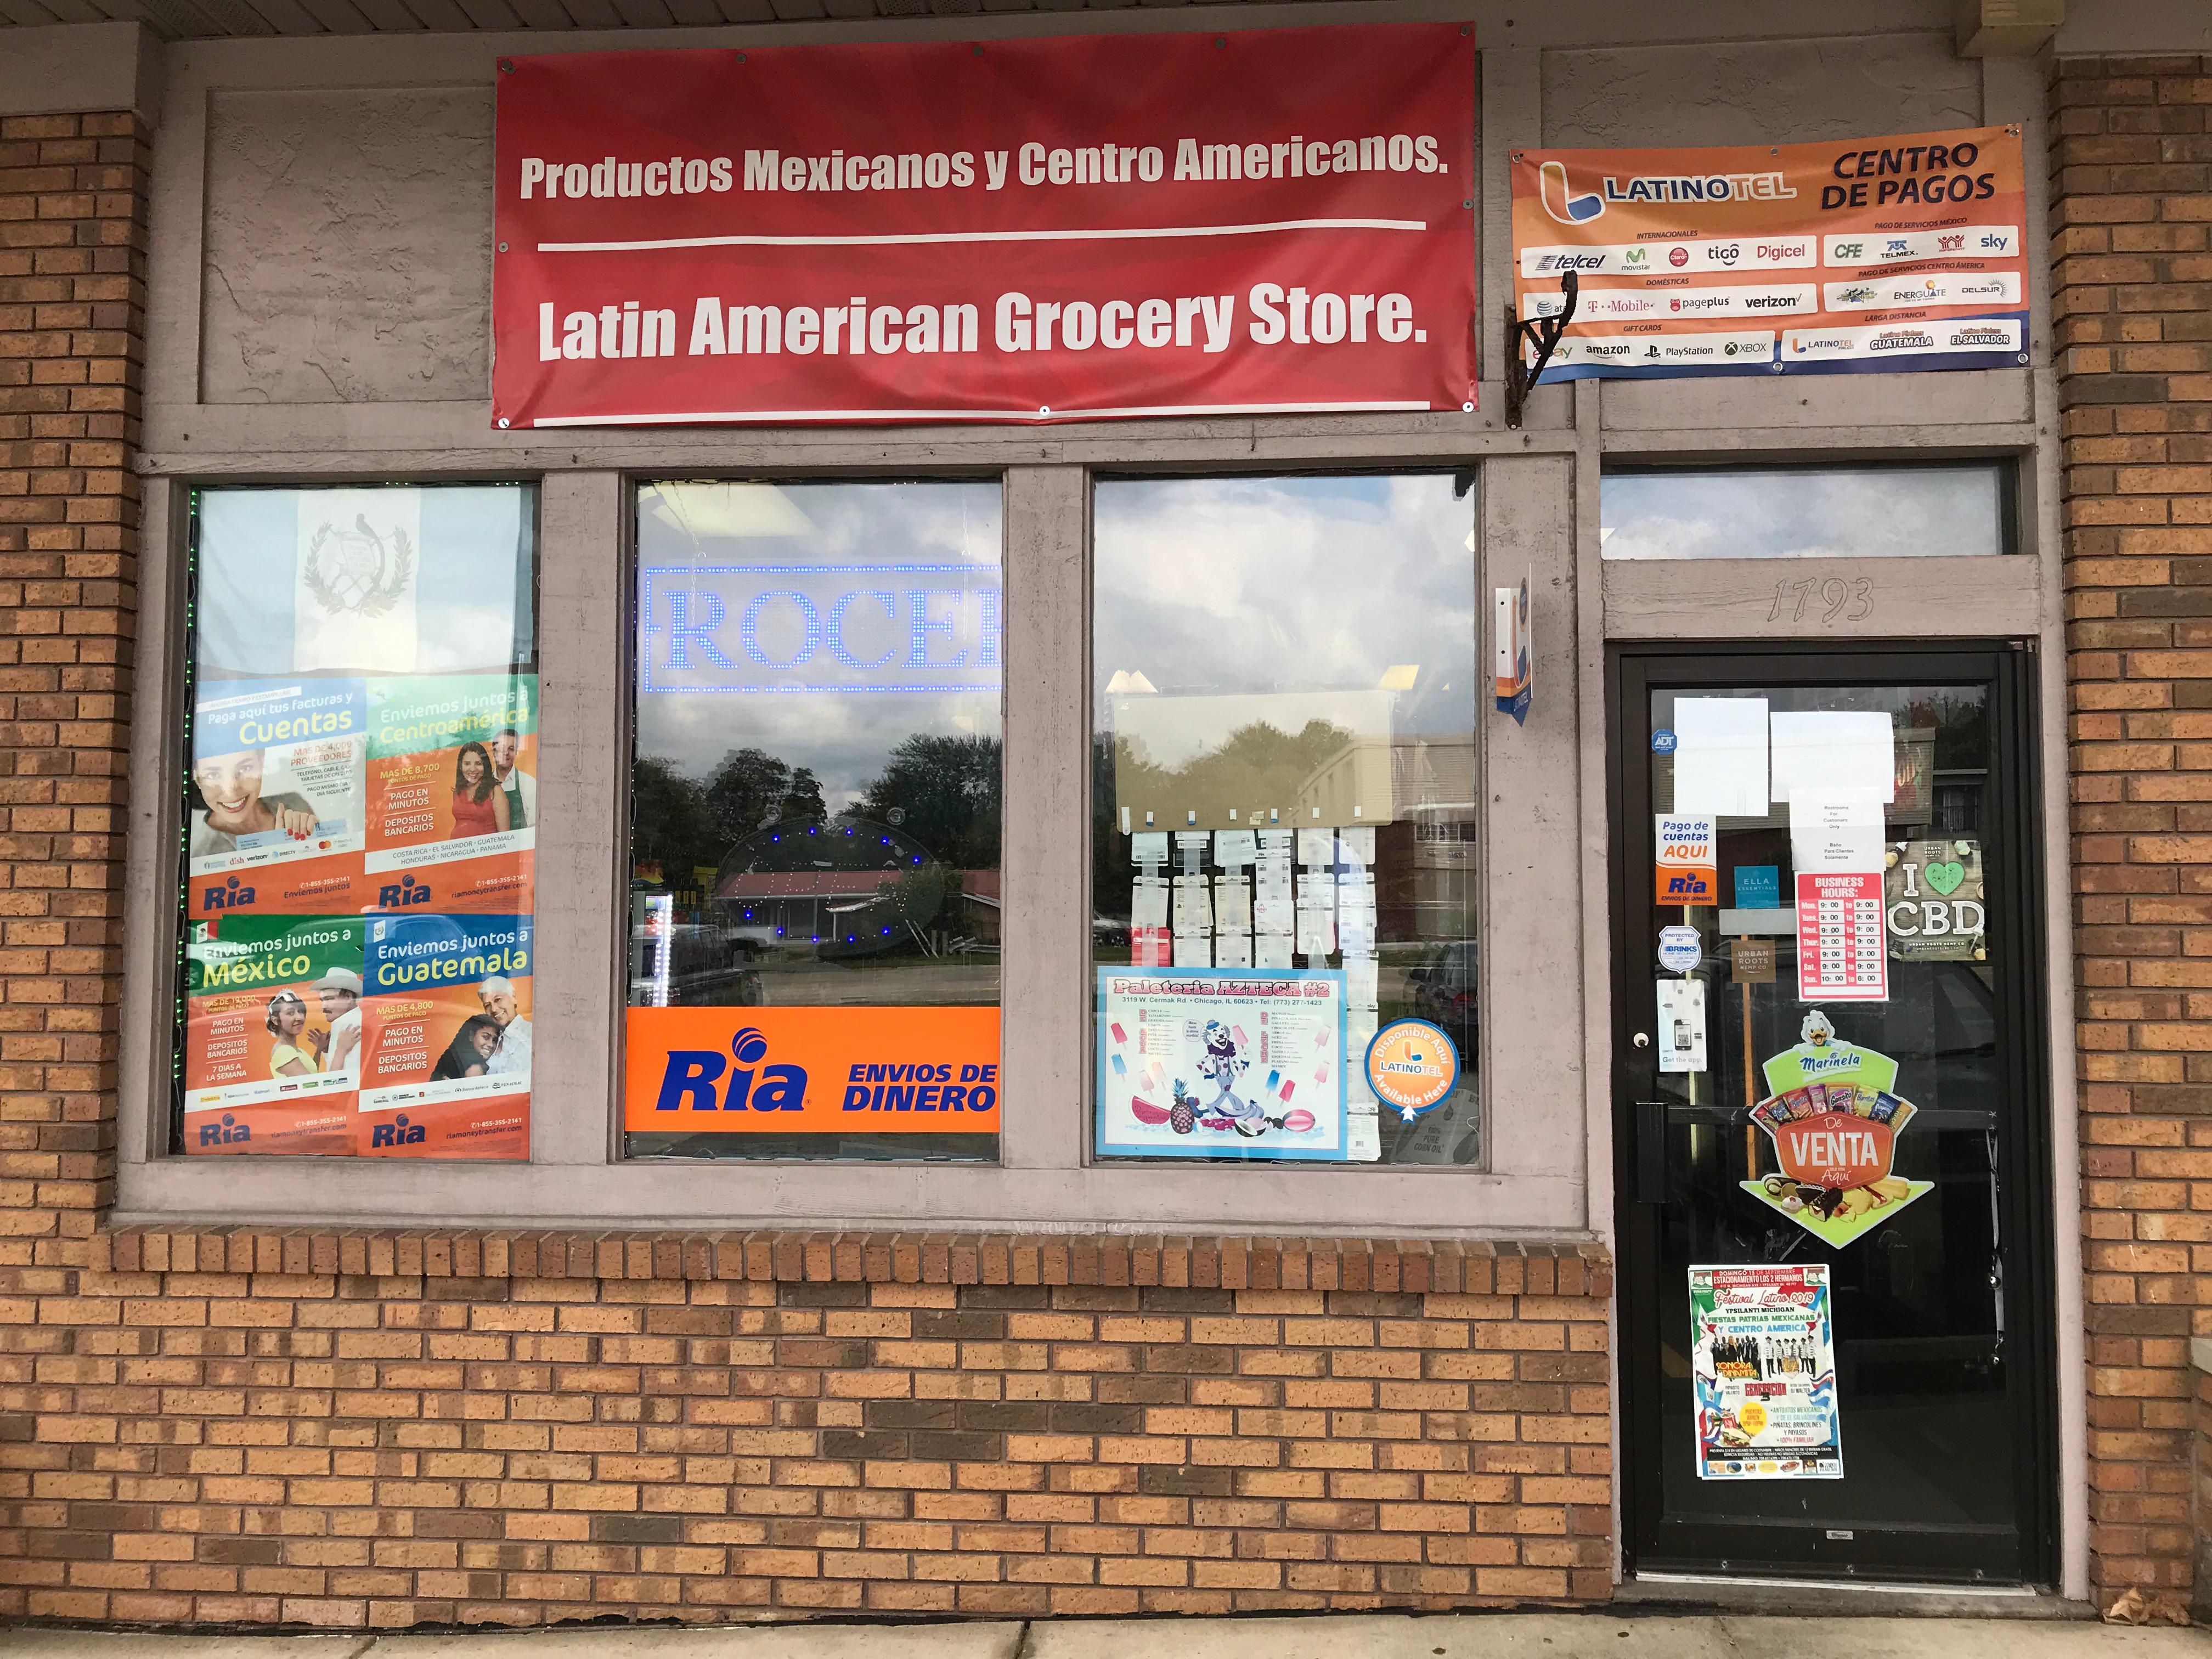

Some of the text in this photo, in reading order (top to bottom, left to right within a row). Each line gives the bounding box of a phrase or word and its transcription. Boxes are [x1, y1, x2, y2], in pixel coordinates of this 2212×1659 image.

[521, 134, 1448, 199] Productos Mexicanos y Centro Americanos.
[1834, 143, 1979, 179] CENTRO
[1607, 171, 1796, 202] LATINOTEL
[1821, 172, 1995, 210] DE PAGOS
[1904, 219, 1938, 228] SERVICIOS
[1939, 217, 1967, 225] MÉXICO
[1637, 230, 1697, 239] INTERNACIONALES
[1981, 234, 2008, 250] sky
[1757, 244, 1805, 261] Digicel
[1834, 244, 1864, 258] CFE
[1554, 255, 1606, 269] telcel
[1890, 264, 1925, 273] SERVICIOS
[1646, 278, 1689, 286] DOMÉSTICAS
[1683, 297, 1729, 308] pageplus
[1746, 296, 1795, 308] verizon
[1894, 289, 1945, 300] ENERGUATE
[539, 283, 1426, 362] Latin American Grocery Store.
[1865, 312, 1926, 321] LARGA DISTANCIA
[1739, 343, 1766, 352] XBOX
[1870, 337, 1933, 350] GUATEMALA
[1961, 335, 2010, 345] SALVADOR
[1586, 345, 1630, 354] amazon
[1666, 346, 1713, 356] PlayStation
[1768, 577, 1874, 623] 1793
[208, 712, 236, 724] Paga
[239, 704, 266, 720] aquí
[270, 703, 289, 713] tus
[292, 695, 342, 710] facturas
[346, 693, 353, 704] y
[381, 689, 528, 723] Enviemos juntos a
[240, 710, 352, 744] Cuentas
[381, 707, 528, 744] Centroamérica
[1655, 736, 1674, 746] ADT
[385, 814, 433, 827] DEPOSITOS
[1663, 821, 1708, 832] Pago de
[385, 823, 433, 837] BANCARIOS
[1663, 833, 1708, 841] cuentas
[441, 842, 472, 850] SALVADOR
[478, 834, 515, 845] GUATEMALA
[401, 844, 505, 865] HONDURAS NICARAGUA PANAMA
[1664, 845, 1707, 859] AQUI
[1668, 872, 1707, 893] Ria
[1815, 877, 1864, 887] BUSINESS
[1903, 864, 1919, 896] I
[204, 876, 255, 911] Ria
[379, 874, 431, 909] Ria
[1821, 888, 1859, 898] HOURS:
[1888, 901, 1985, 936] CBD
[204, 929, 351, 959] Enviemos juntos a
[378, 930, 528, 959] Enviemos juntos a
[203, 955, 310, 988] México
[378, 947, 527, 986] Guatemala
[1114, 979, 1330, 997] Paleteria AZTECA #2
[376, 1006, 395, 1015] MAS
[410, 1001, 433, 1011] 4,800
[1375, 1027, 1451, 1064] Disponible Aquí
[656, 1028, 808, 1111] Ria
[1380, 1062, 1442, 1076] LATINOTEL
[1799, 1053, 1860, 1072] Marinela
[848, 1064, 998, 1082] ENVIOS DE
[1374, 1074, 1447, 1104] Available Here
[843, 1086, 996, 1111] DINERO
[1831, 1092, 1852, 1105] Gansito
[200, 1113, 251, 1147] Ria
[372, 1113, 426, 1148] Ria
[1824, 1116, 1843, 1130] De
[1790, 1132, 1879, 1167] VENTA
[1821, 1169, 1851, 1186] Aquí
[1715, 1289, 1814, 1307] Festival Latino 2019
